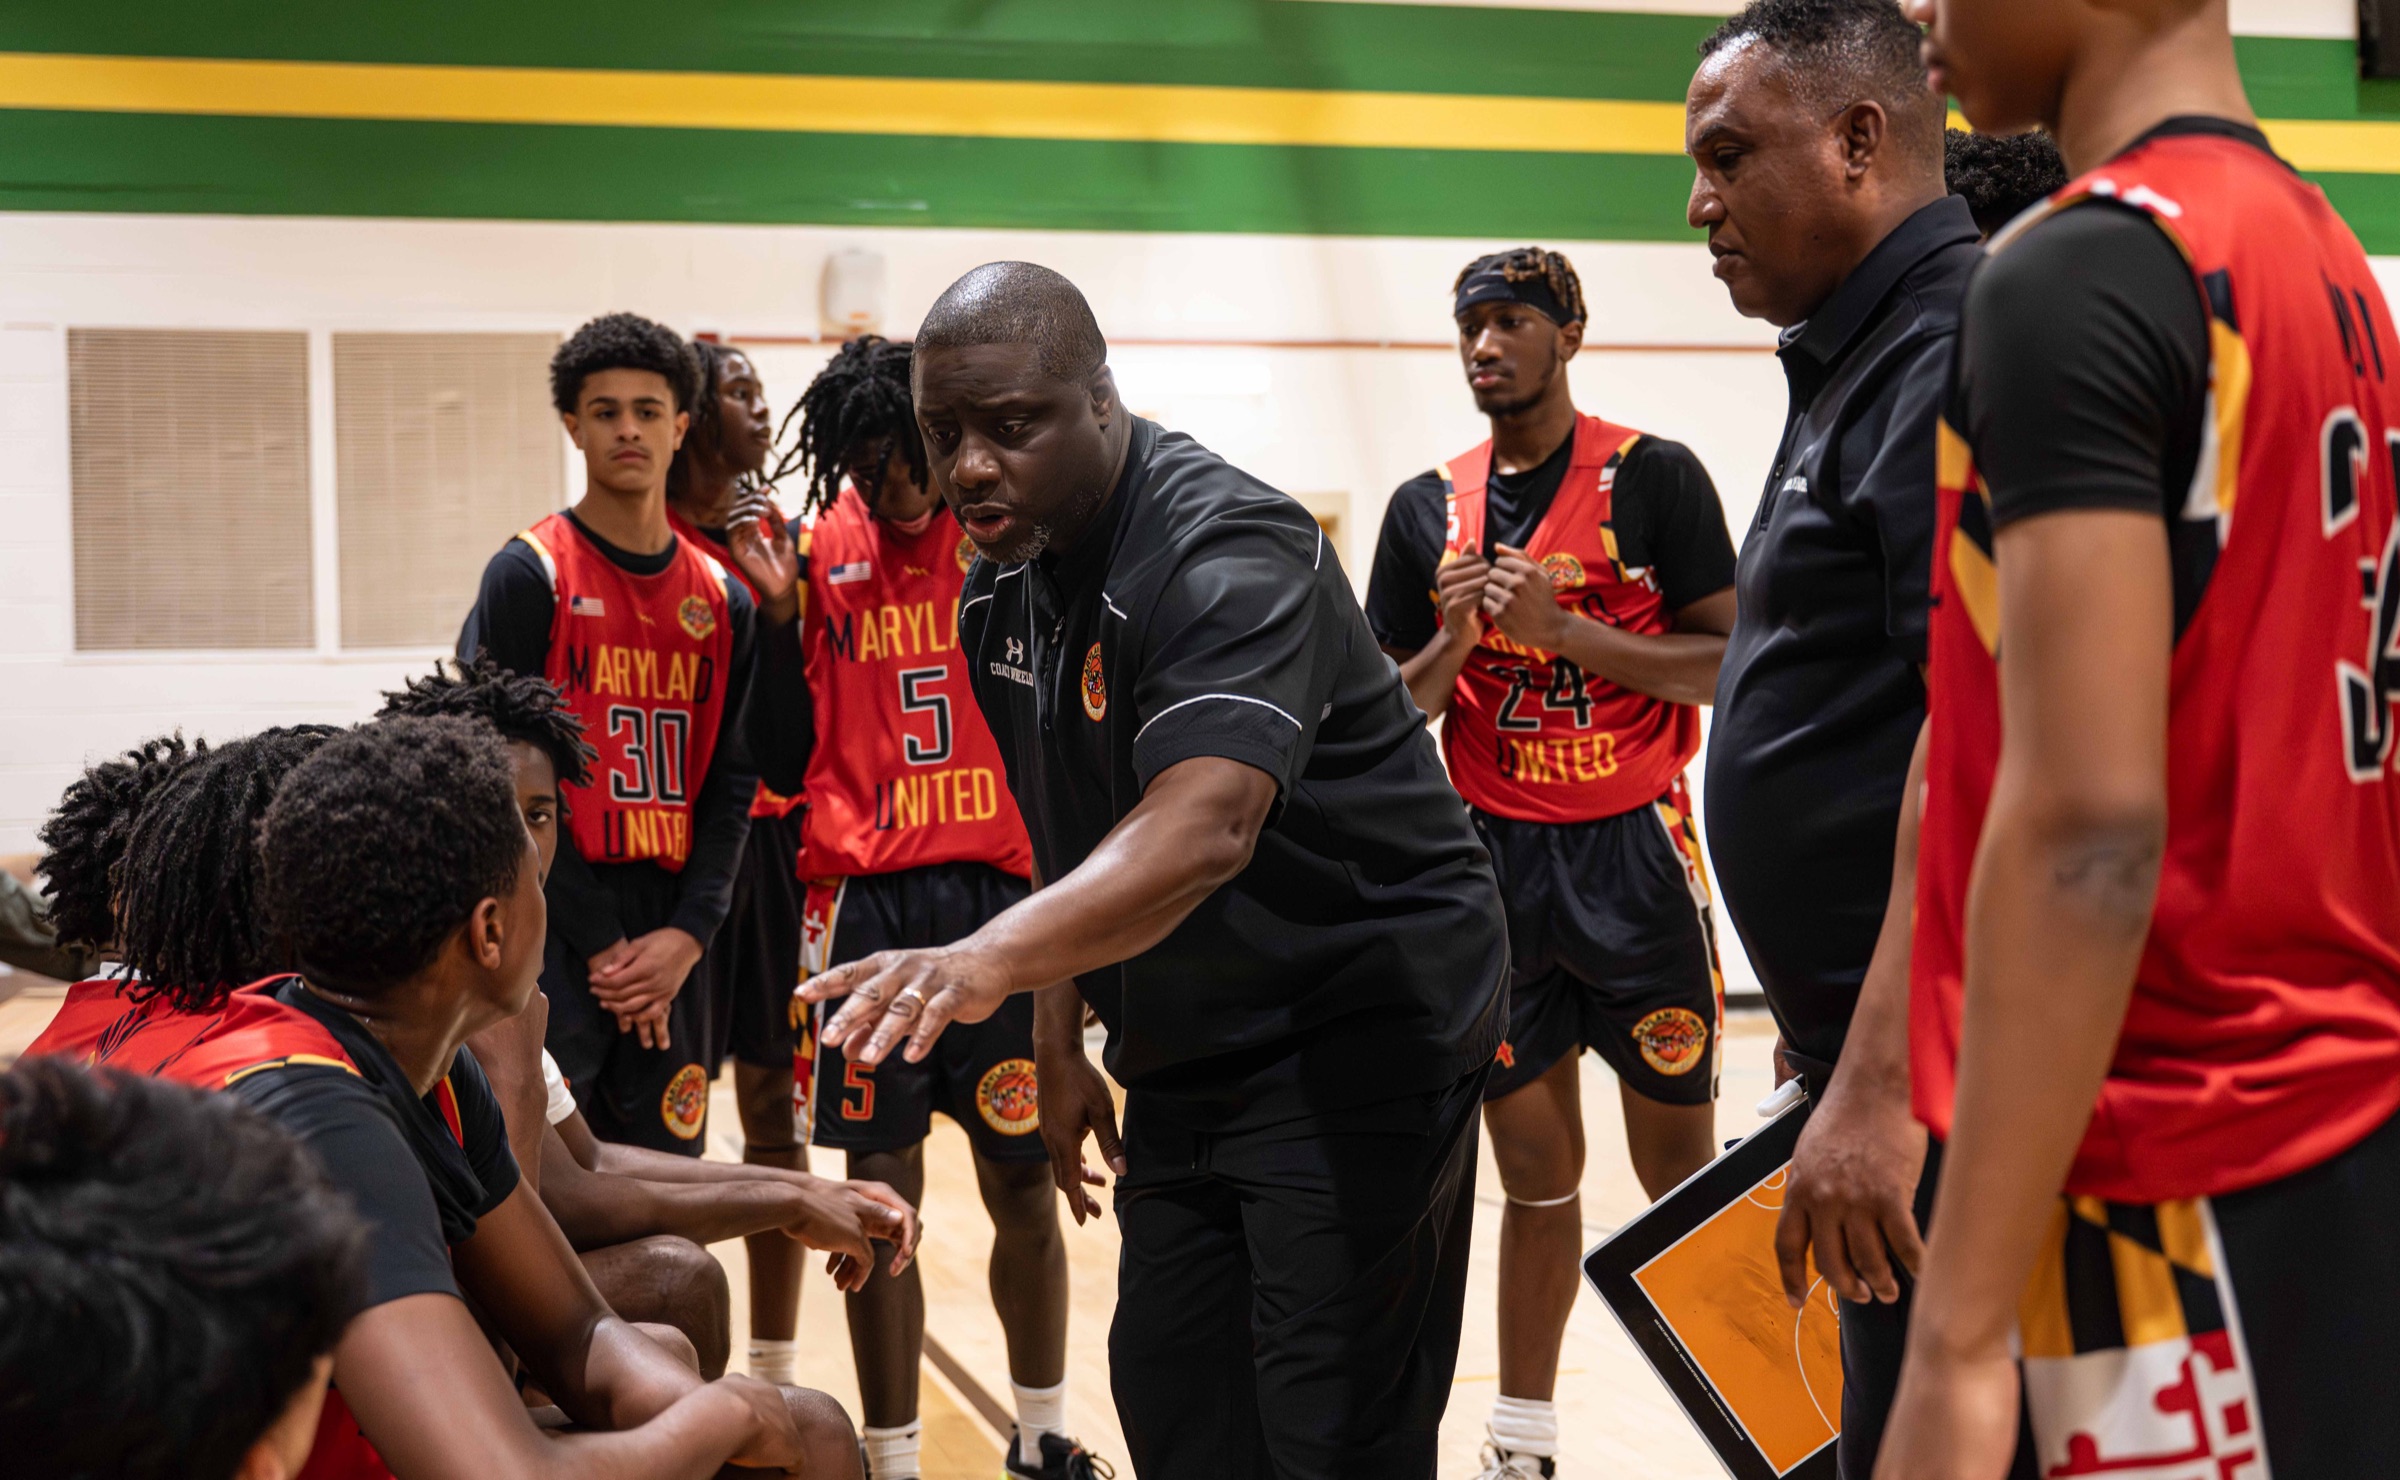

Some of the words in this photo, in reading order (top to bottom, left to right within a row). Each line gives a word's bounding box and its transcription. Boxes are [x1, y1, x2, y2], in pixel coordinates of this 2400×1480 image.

[898, 666, 952, 766] 5
[1487, 657, 1595, 732] 24
[608, 704, 690, 805] 30
[1496, 732, 1619, 784] UNITED
[875, 767, 997, 831] UNITED
[841, 1061, 876, 1120] 5
